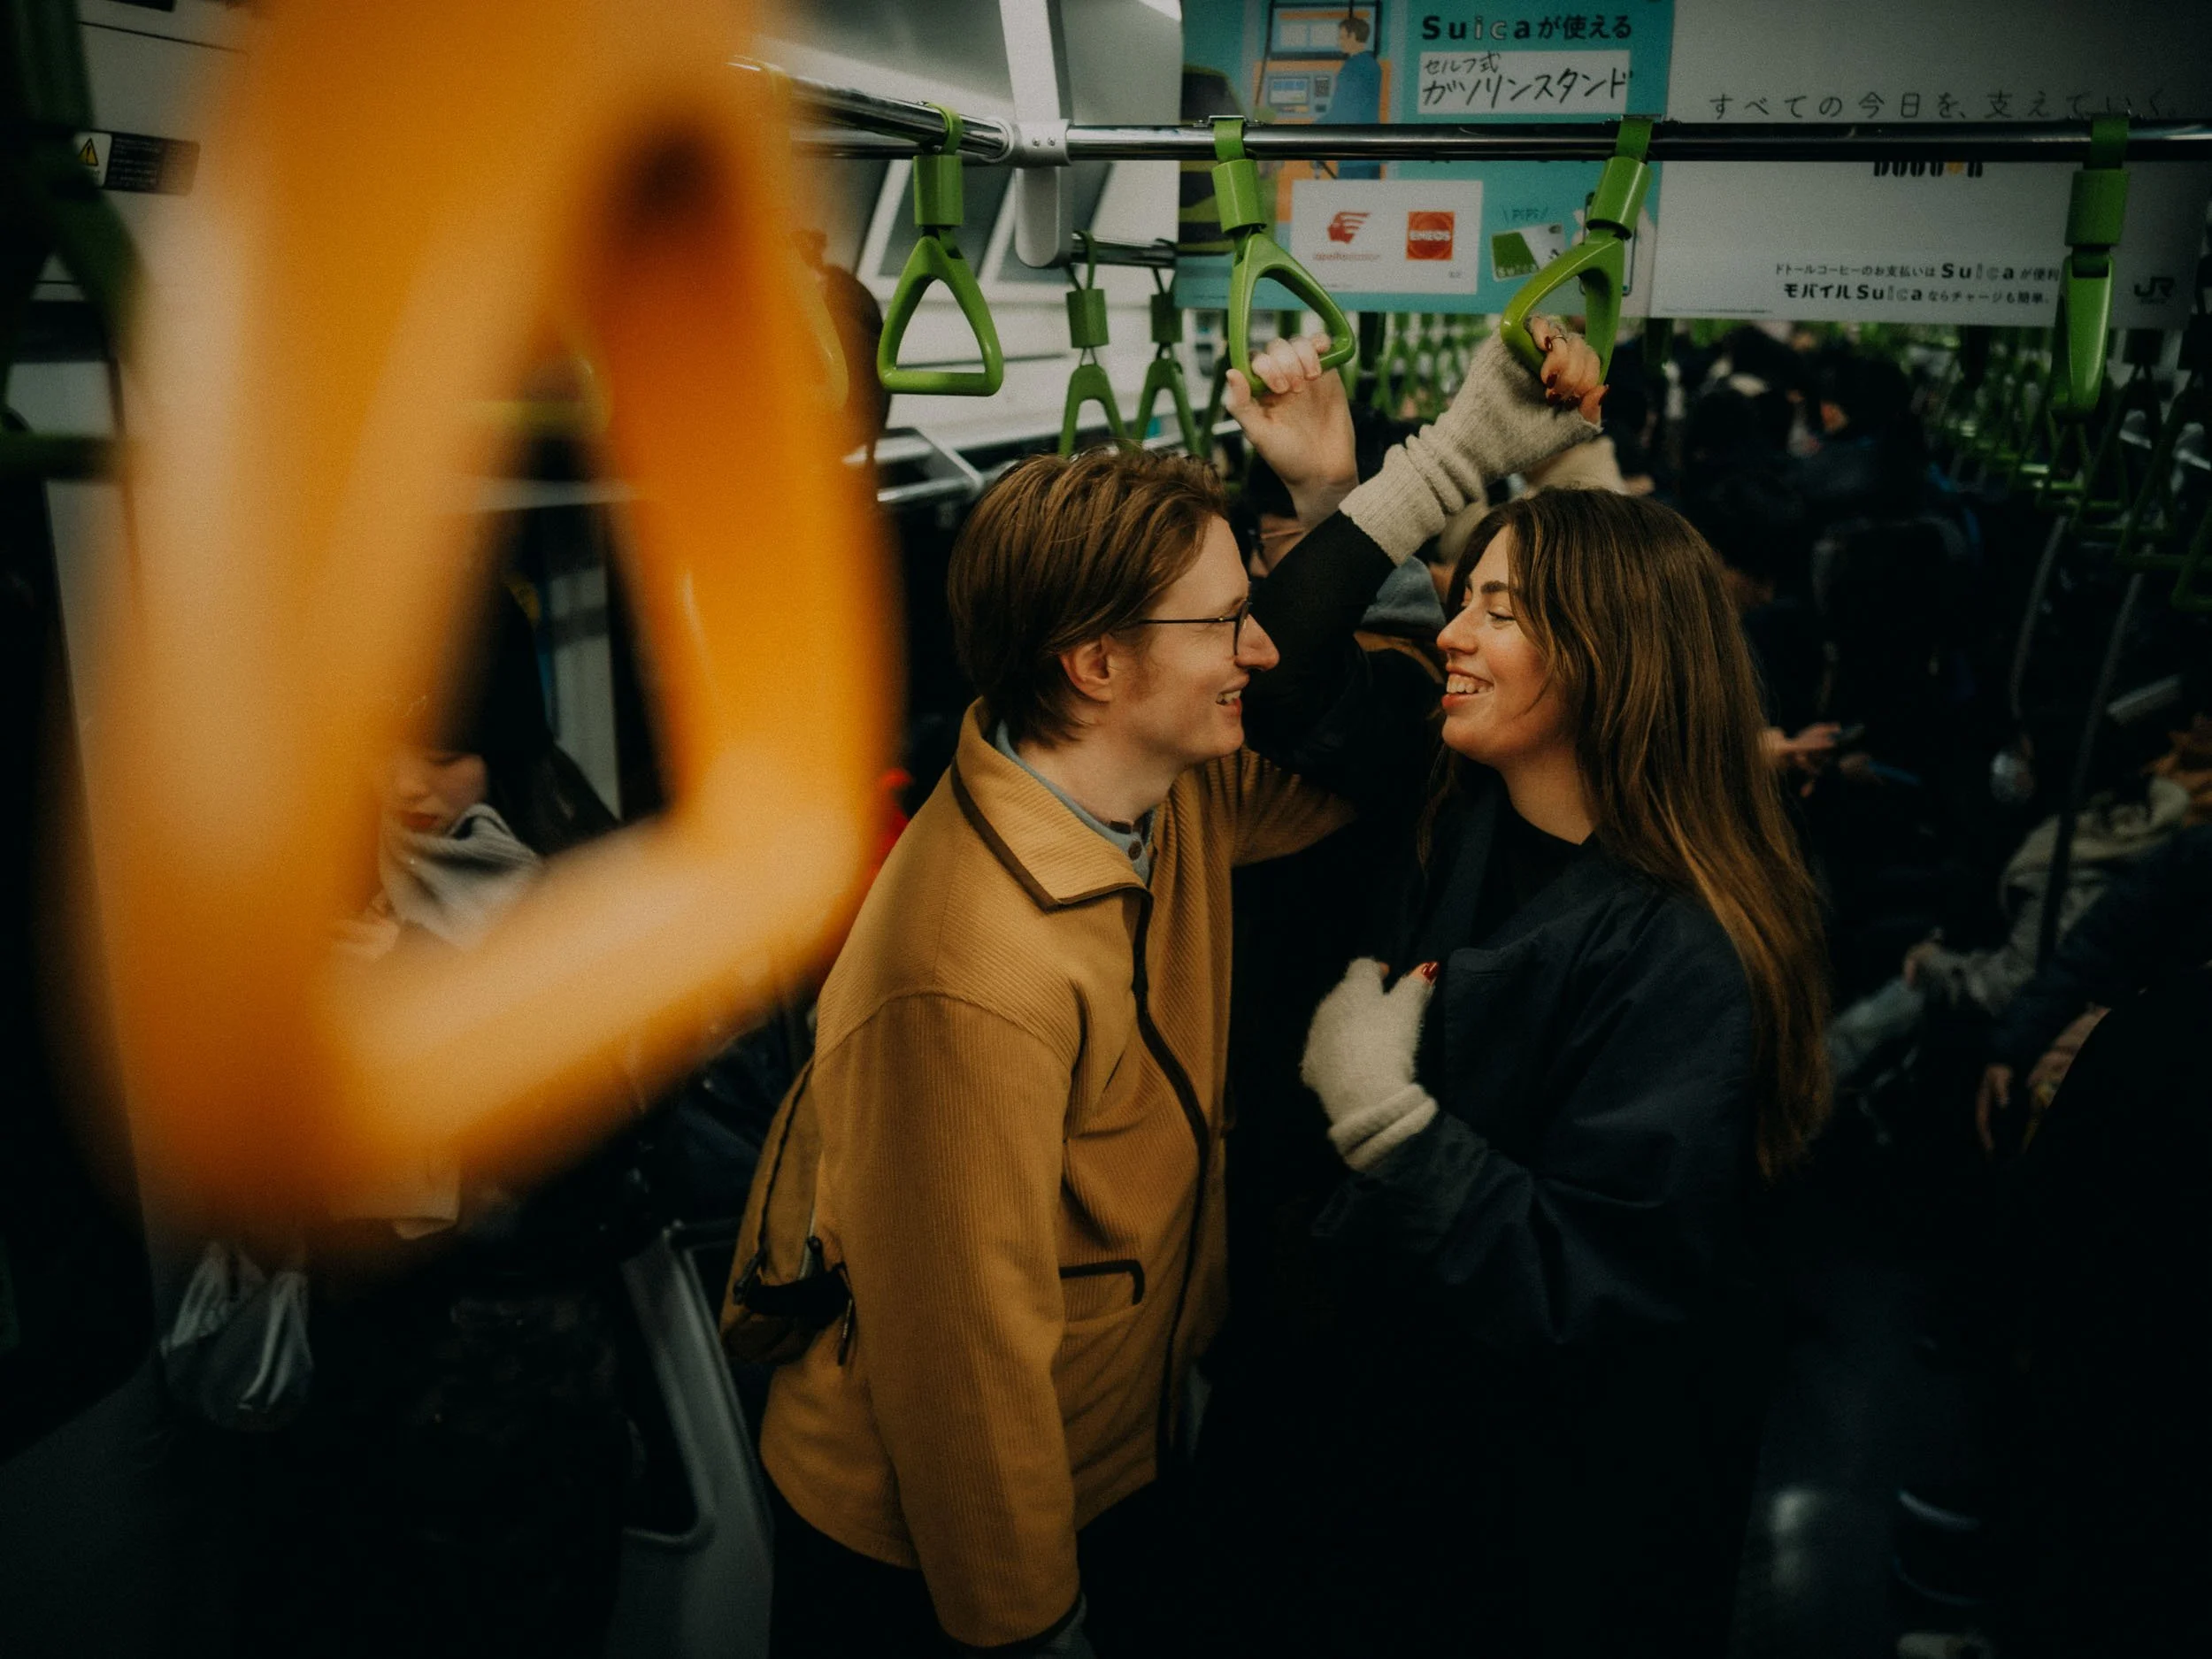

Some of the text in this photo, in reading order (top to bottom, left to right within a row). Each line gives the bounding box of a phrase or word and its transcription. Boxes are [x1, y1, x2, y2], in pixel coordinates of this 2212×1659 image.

[1422, 15, 1632, 41] Suicaが使える
[1423, 51, 1502, 75] セルフ式
[1422, 68, 1633, 109] ガソリンスタンド
[2133, 276, 2176, 297] JR
